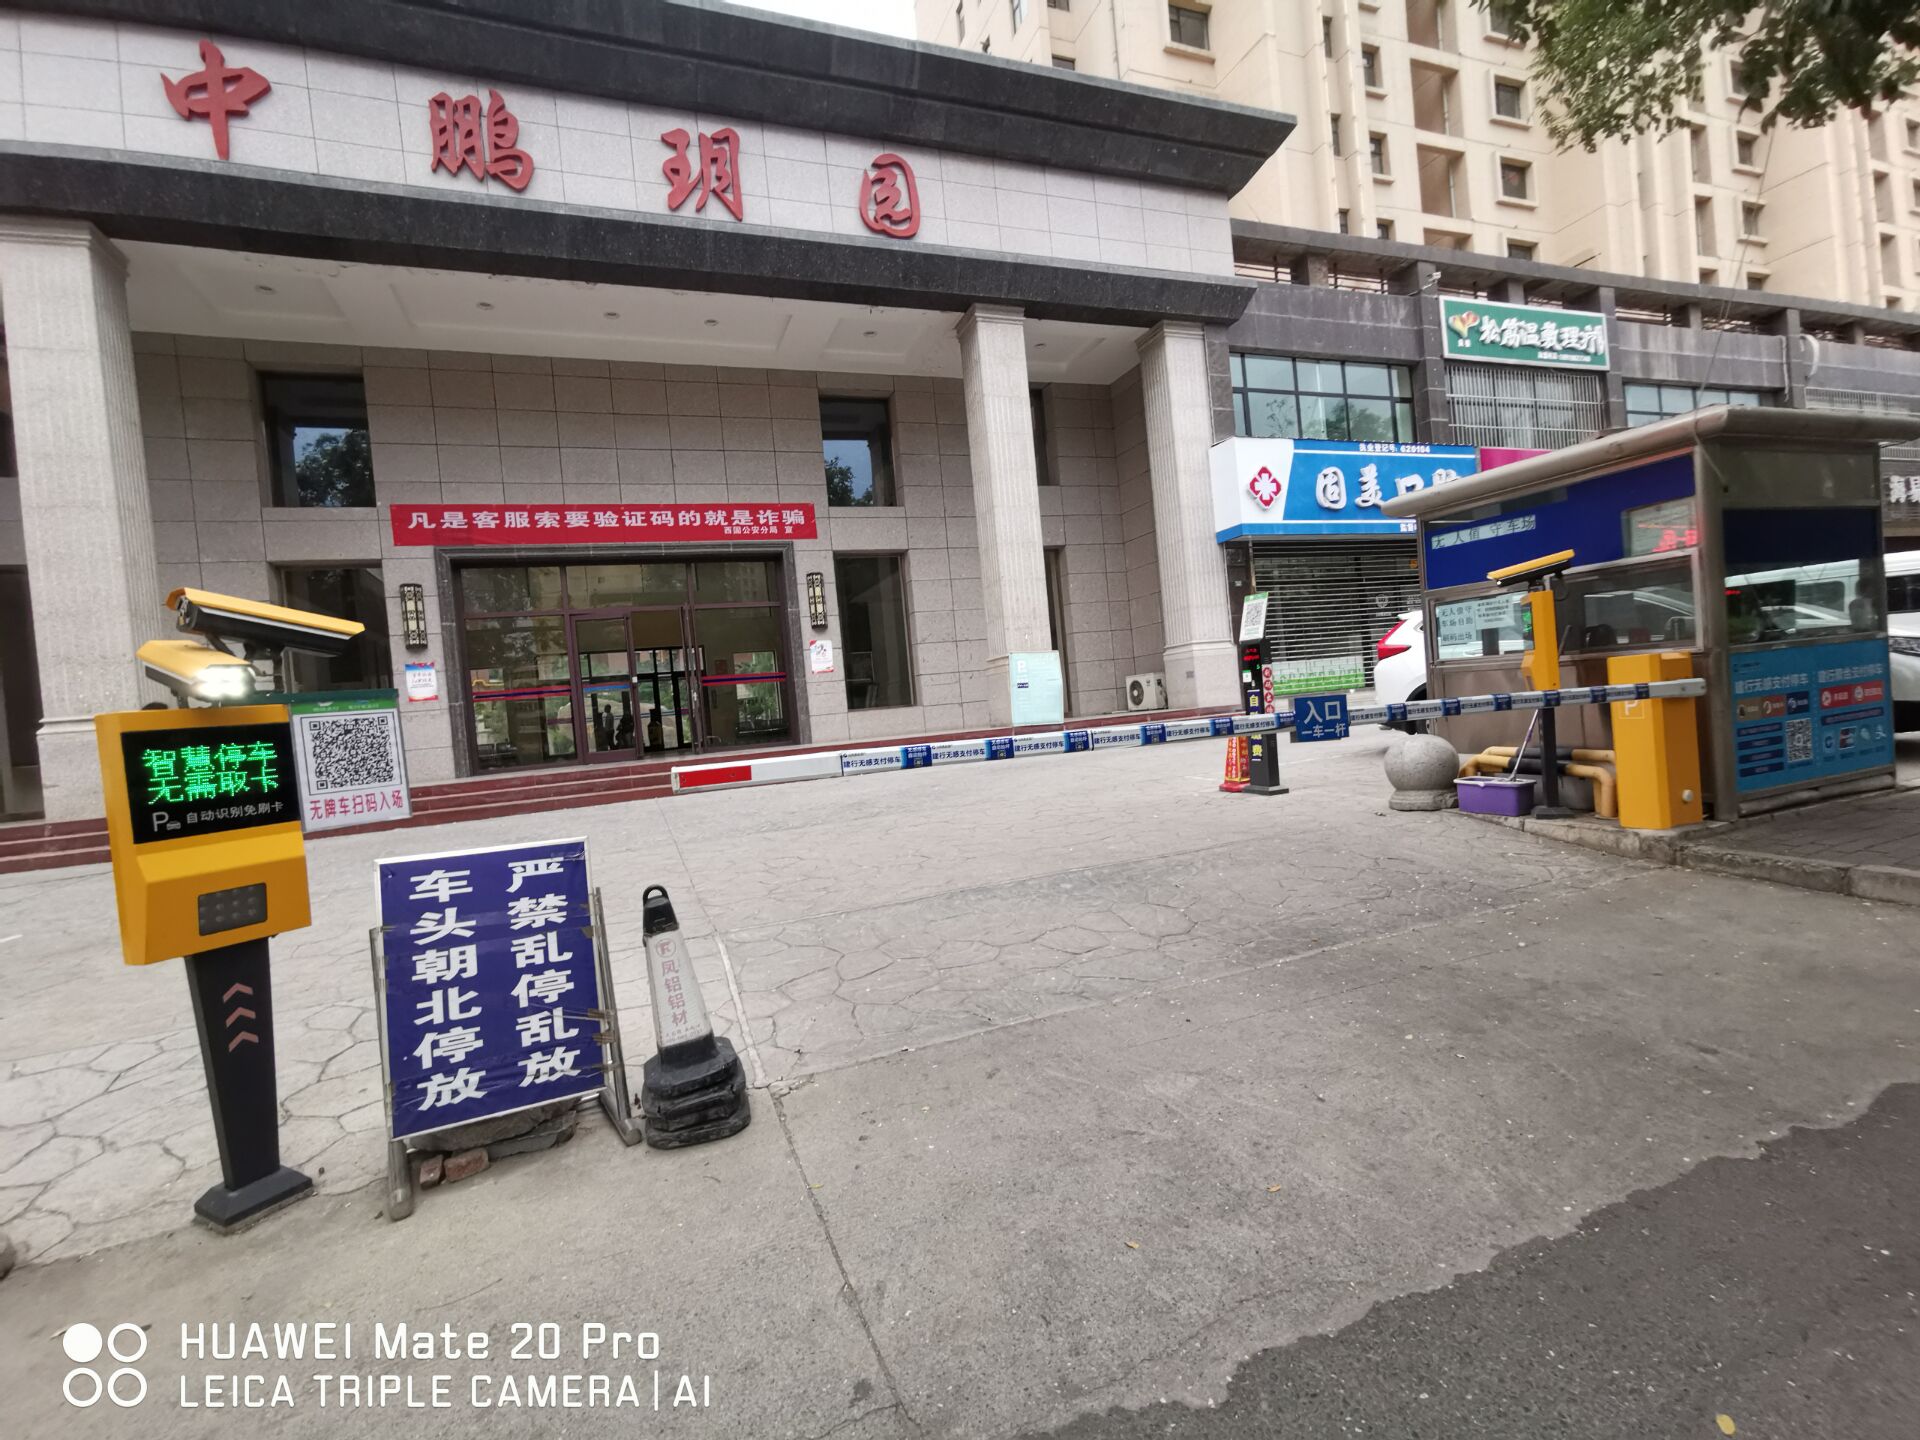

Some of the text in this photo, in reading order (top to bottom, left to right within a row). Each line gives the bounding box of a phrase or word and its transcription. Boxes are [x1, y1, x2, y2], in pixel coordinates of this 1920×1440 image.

[408, 509, 806, 530] 凡是客服索要验证码的就是诈骗
[1304, 701, 1341, 724] 入口
[1302, 723, 1346, 739] 一车一杆
[142, 740, 278, 777] 智慧停车
[843, 756, 901, 769] 建行无感支付停车
[932, 748, 985, 760] 建行无感支付停车
[148, 766, 279, 805] 无需取卡
[186, 801, 284, 824] 自动识别免刷卡
[310, 790, 404, 820] 无牌车扫码入场
[505, 856, 582, 1088] 严禁乱停乱放
[409, 869, 488, 1112] 车头朝北停放
[661, 959, 688, 1027] 凤铝铝材
